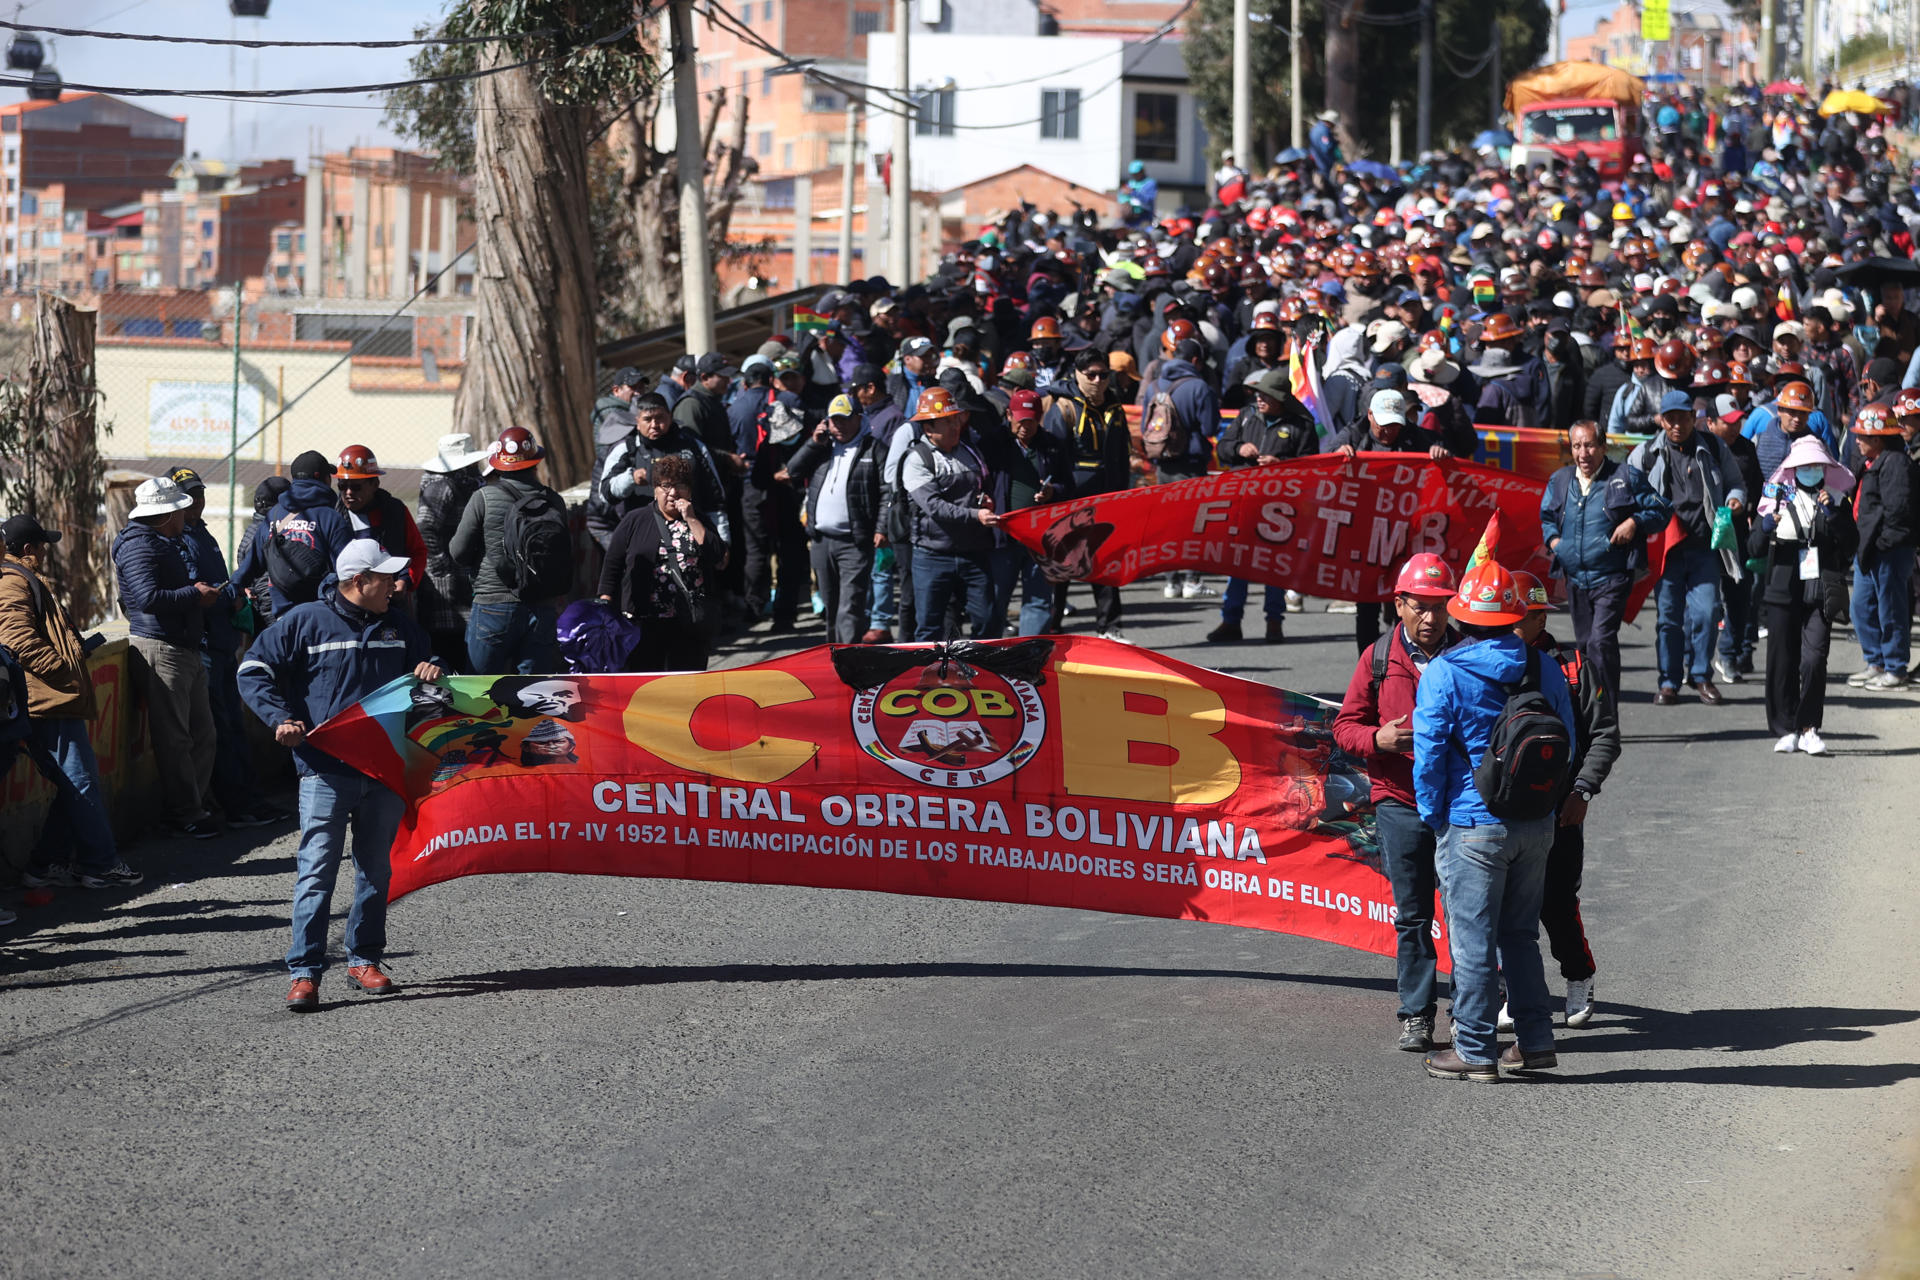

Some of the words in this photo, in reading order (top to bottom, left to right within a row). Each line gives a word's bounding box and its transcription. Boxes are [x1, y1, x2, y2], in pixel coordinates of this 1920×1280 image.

[201, 418, 231, 432] TEJA
[1161, 478, 1303, 504] MINEROS
[1316, 480, 1360, 507] DE
[1375, 487, 1498, 516] BOLIVIA
[1393, 464, 1435, 488] DE
[1447, 471, 1543, 496] TRABA
[269, 520, 316, 532] GERS
[1103, 540, 1293, 577] PRESENTES
[1316, 563, 1361, 594] EN
[857, 686, 879, 724] CENT
[1008, 677, 1040, 723] VIANA
[880, 688, 1017, 718] COB
[920, 769, 987, 787] CEN
[592, 780, 806, 823] CENTRAL
[820, 793, 1011, 834] OBRERA
[1025, 803, 1267, 864] BOLIVIANA
[515, 822, 541, 840] EL
[548, 822, 571, 840] 17
[615, 823, 667, 844] 1952
[674, 826, 700, 846] LA
[707, 828, 873, 857] EMANCIPACIÓN
[880, 839, 908, 858] DE
[915, 840, 958, 862] LOS
[964, 844, 1136, 879] TRABAJADORES
[1142, 862, 1198, 886] SERÁ
[1204, 868, 1262, 895] OBRA
[1268, 877, 1294, 901] DE
[1300, 884, 1362, 916] ELLOS
[1368, 900, 1442, 940] MISS
